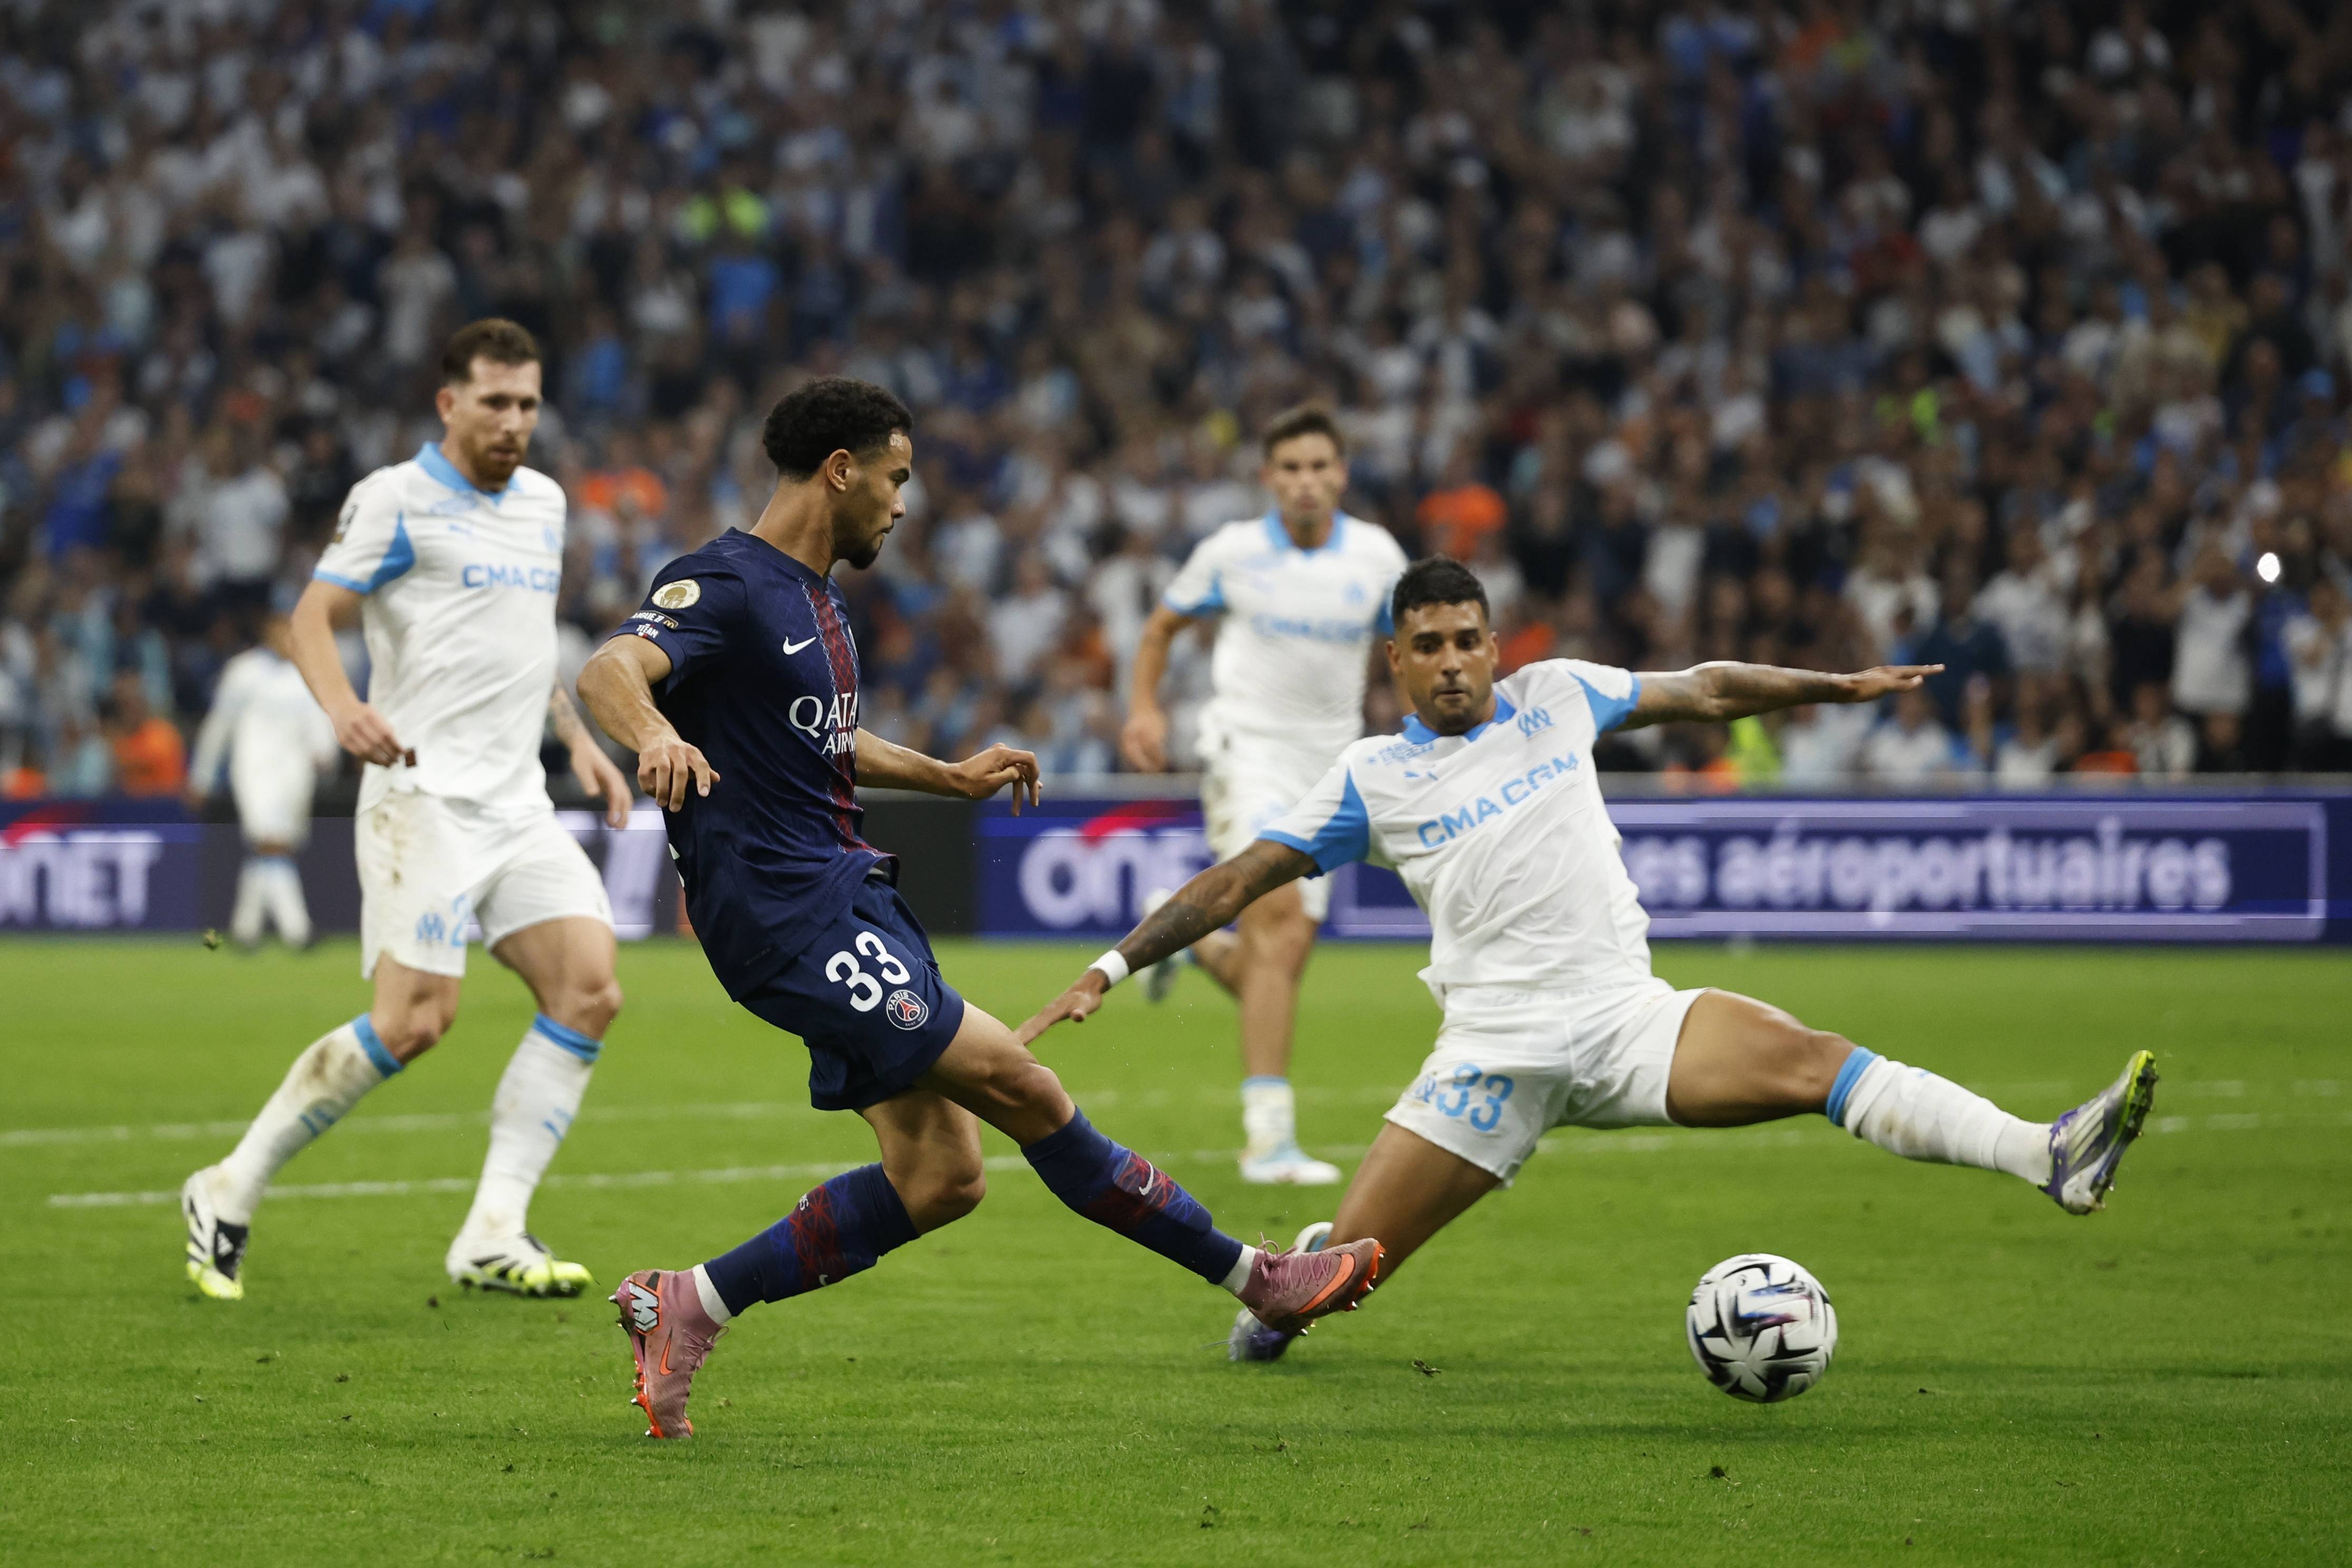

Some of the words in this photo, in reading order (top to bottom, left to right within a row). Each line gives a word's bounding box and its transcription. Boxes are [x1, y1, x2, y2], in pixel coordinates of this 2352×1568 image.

[464, 564, 526, 590] CMA
[530, 567, 561, 596] CG
[789, 691, 859, 738] QATA
[822, 731, 856, 754] AIRW
[1417, 796, 1502, 849] CMA
[1502, 750, 1579, 806] CGM
[1717, 815, 2230, 926] aéroportuaires
[825, 931, 910, 1012] 33
[888, 992, 909, 1011] PARIS
[1436, 1062, 1515, 1131] 33
